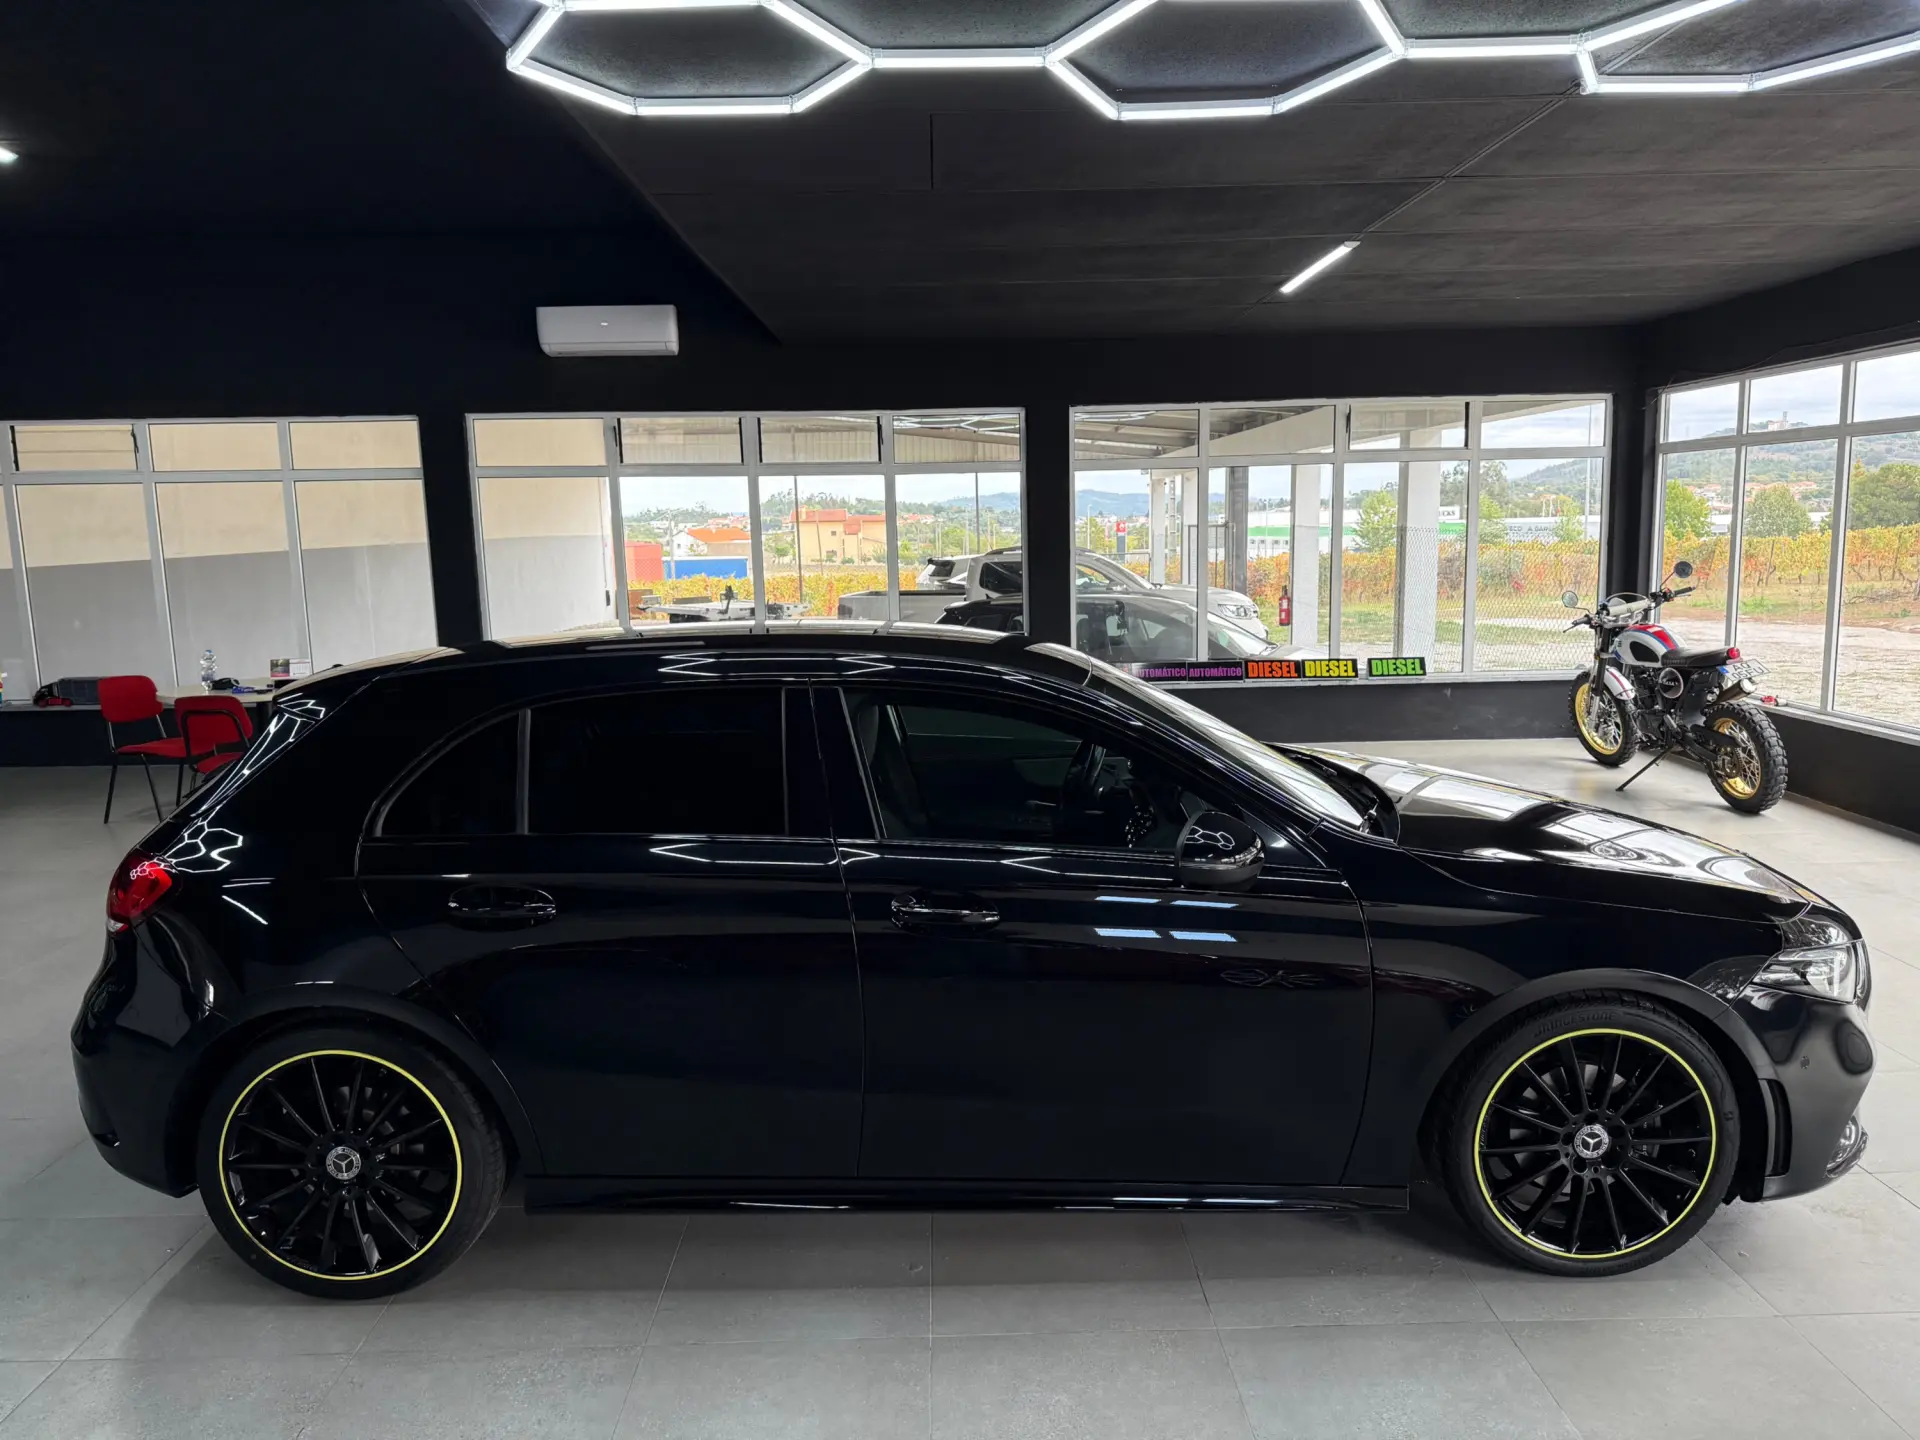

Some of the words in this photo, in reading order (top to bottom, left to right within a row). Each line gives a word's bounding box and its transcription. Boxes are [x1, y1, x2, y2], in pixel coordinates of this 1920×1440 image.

[1189, 666, 1242, 677] AUTOMÁTICO
[1247, 661, 1298, 677] DIESEL
[1304, 660, 1356, 677] DIESEL
[1371, 659, 1424, 676] DIESEL
